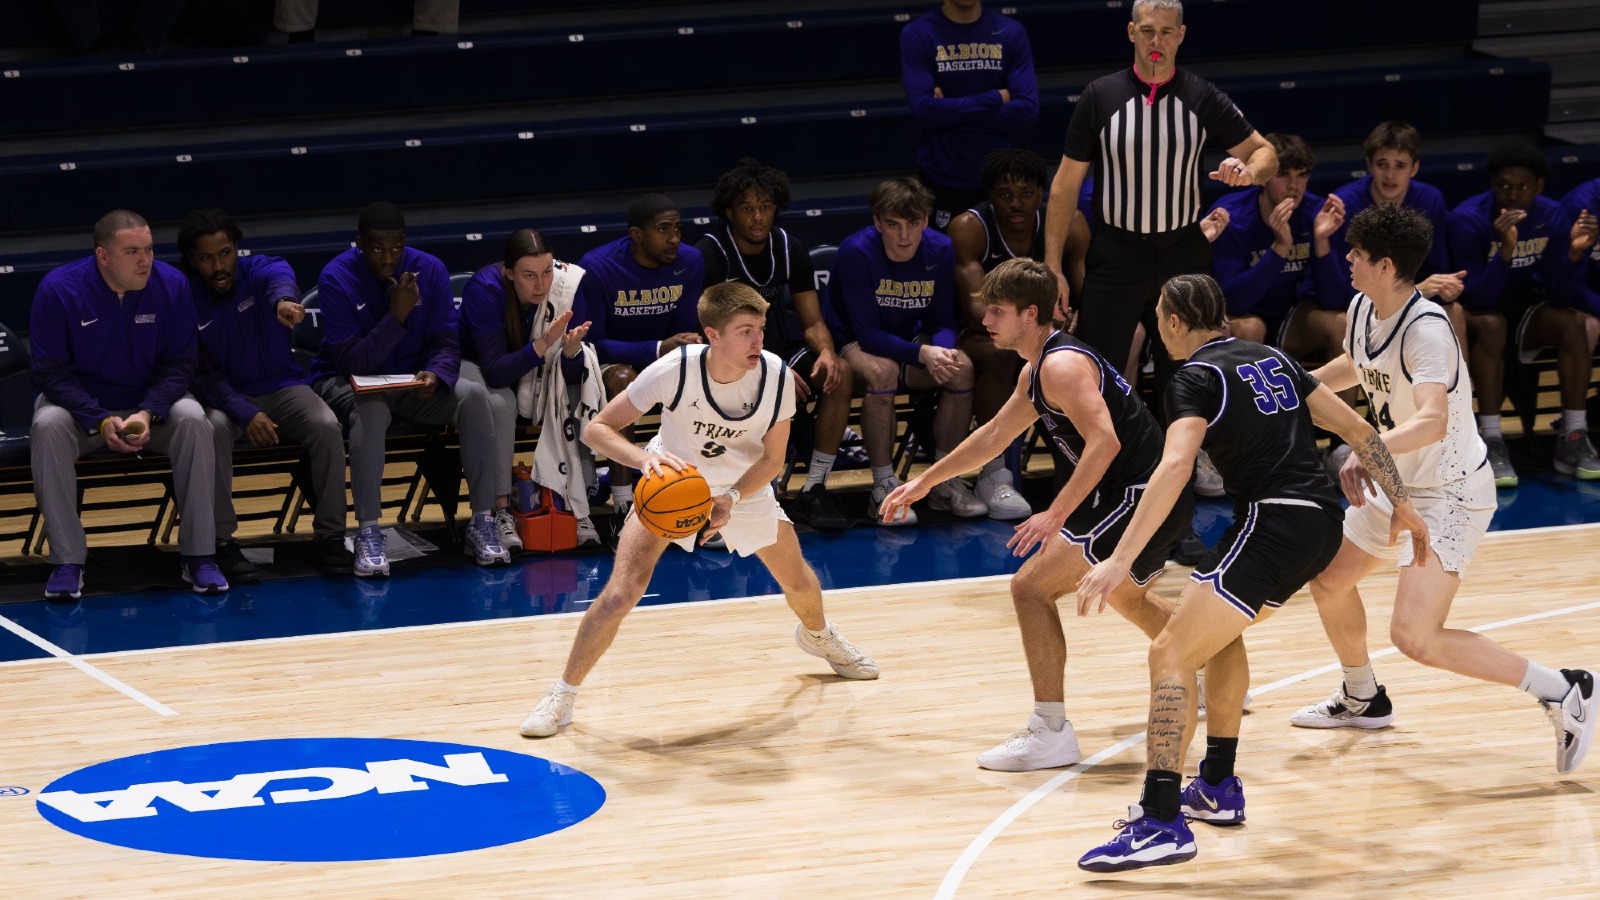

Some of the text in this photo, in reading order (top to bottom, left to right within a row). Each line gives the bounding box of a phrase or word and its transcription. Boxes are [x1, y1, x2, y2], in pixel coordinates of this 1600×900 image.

[935, 42, 1003, 61] ALBION
[937, 60, 1002, 72] BASKETBALL
[614, 285, 683, 306] ALBION
[875, 279, 934, 298] ALBION
[1236, 357, 1299, 415] 35
[693, 421, 748, 439] TRINE
[37, 752, 509, 822] NCAA
